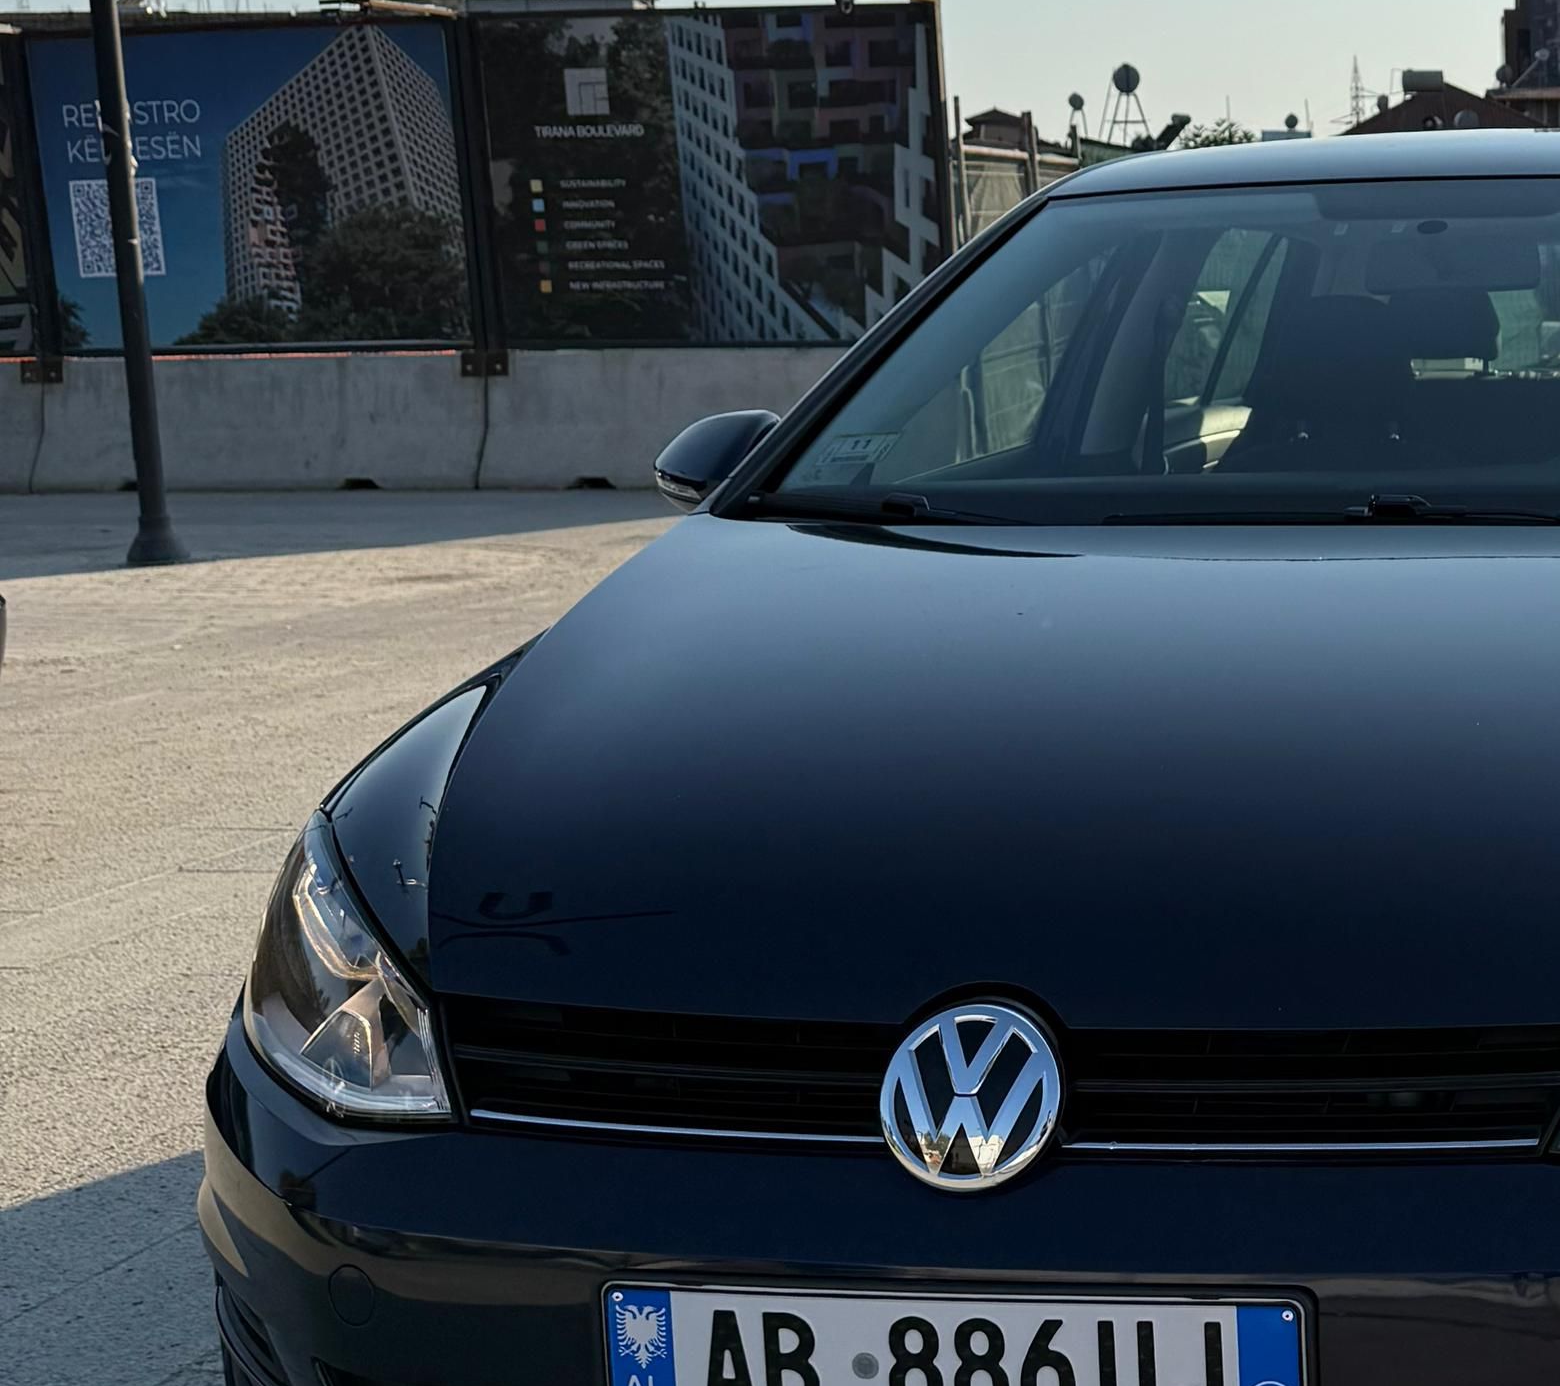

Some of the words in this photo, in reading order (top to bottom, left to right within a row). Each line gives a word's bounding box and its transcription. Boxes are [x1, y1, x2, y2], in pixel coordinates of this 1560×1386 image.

[62, 99, 200, 128] RESTRO
[534, 125, 575, 138] TIRANA
[577, 124, 645, 138] BOULEVARD
[67, 131, 201, 163] KËESËN
[560, 179, 626, 188] SUSTAINABILITY
[562, 199, 615, 209] INNOVATION
[564, 220, 615, 230] COMMUNITY
[566, 240, 595, 250] GREEN
[568, 260, 632, 270] RECREATIONAL
[633, 260, 665, 269] SPACES
[569, 280, 590, 289] NEW
[591, 280, 665, 289] INFRASTRUCTURE
